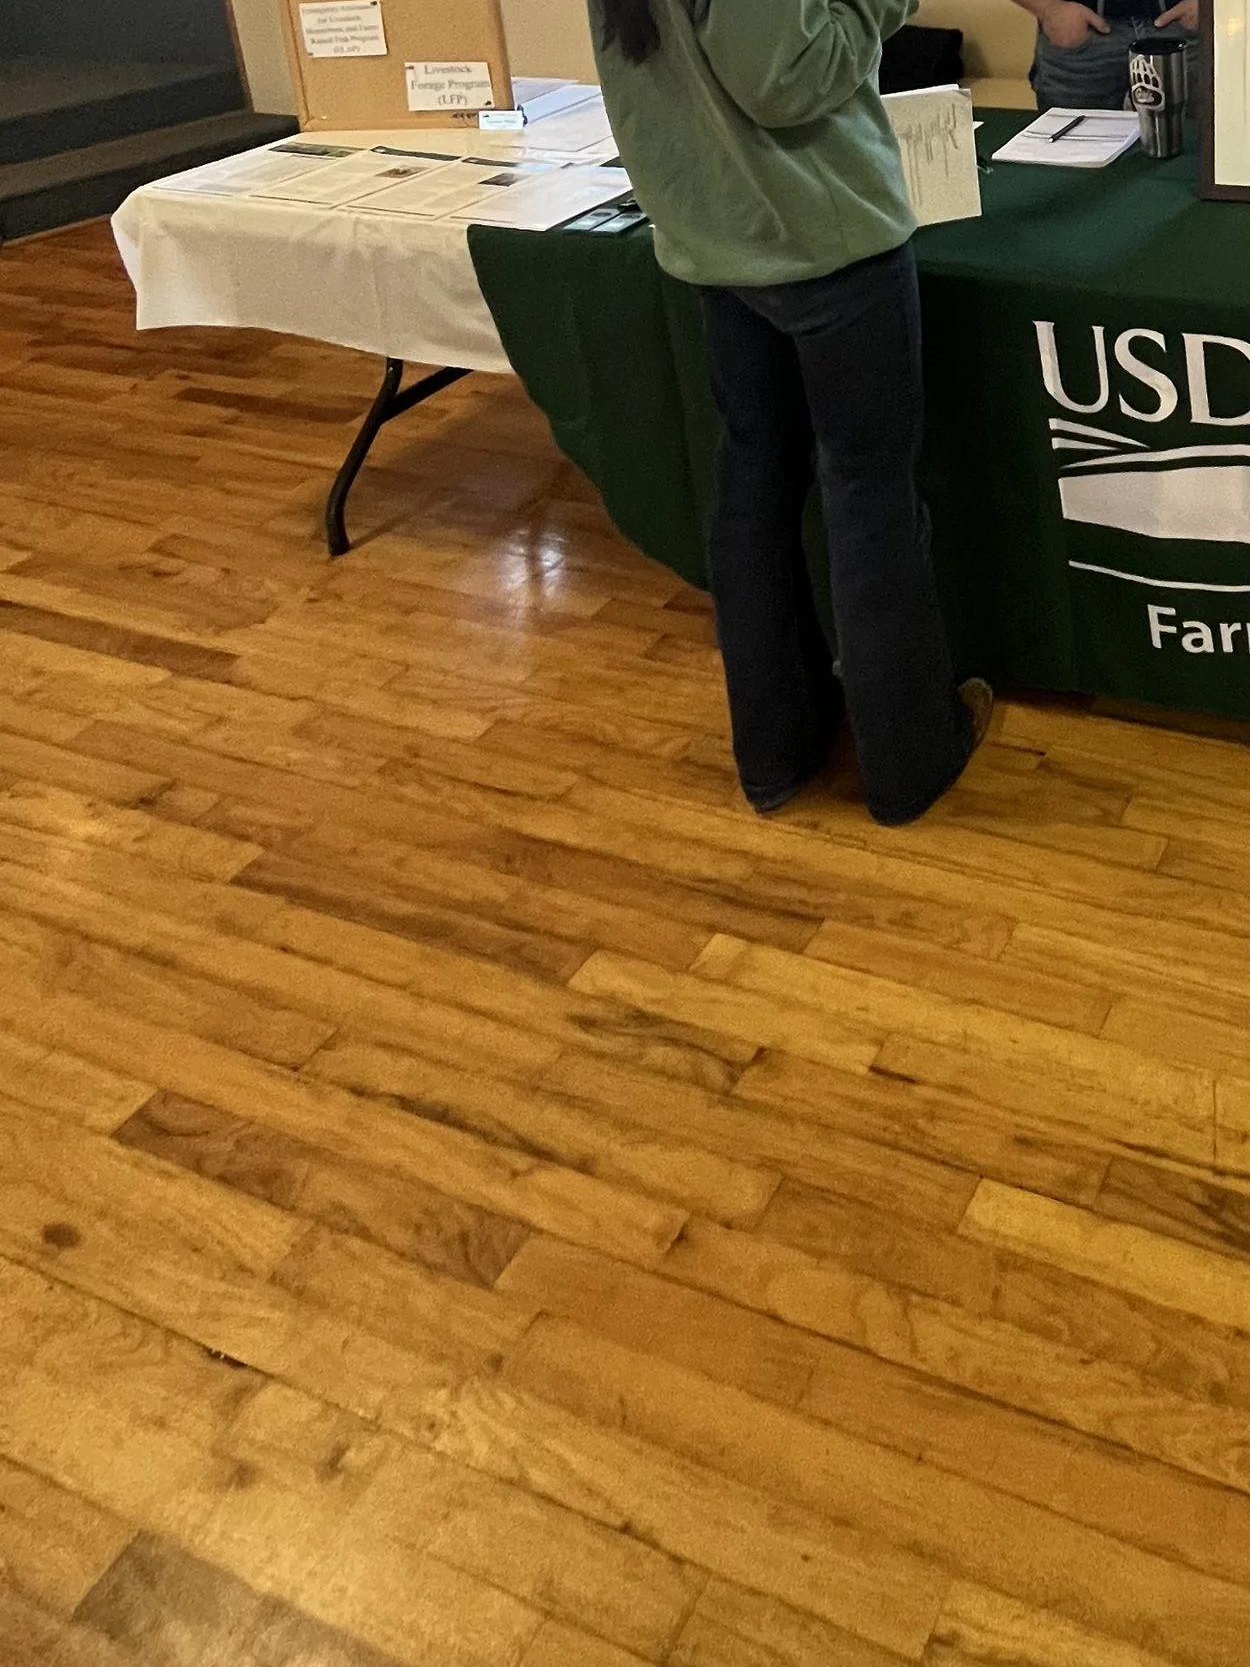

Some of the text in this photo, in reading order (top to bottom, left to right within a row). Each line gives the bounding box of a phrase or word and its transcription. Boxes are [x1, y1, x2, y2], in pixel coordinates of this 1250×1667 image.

[424, 64, 473, 75] Livestock
[411, 79, 491, 92] Forage Program
[438, 94, 468, 106] (LFP)
